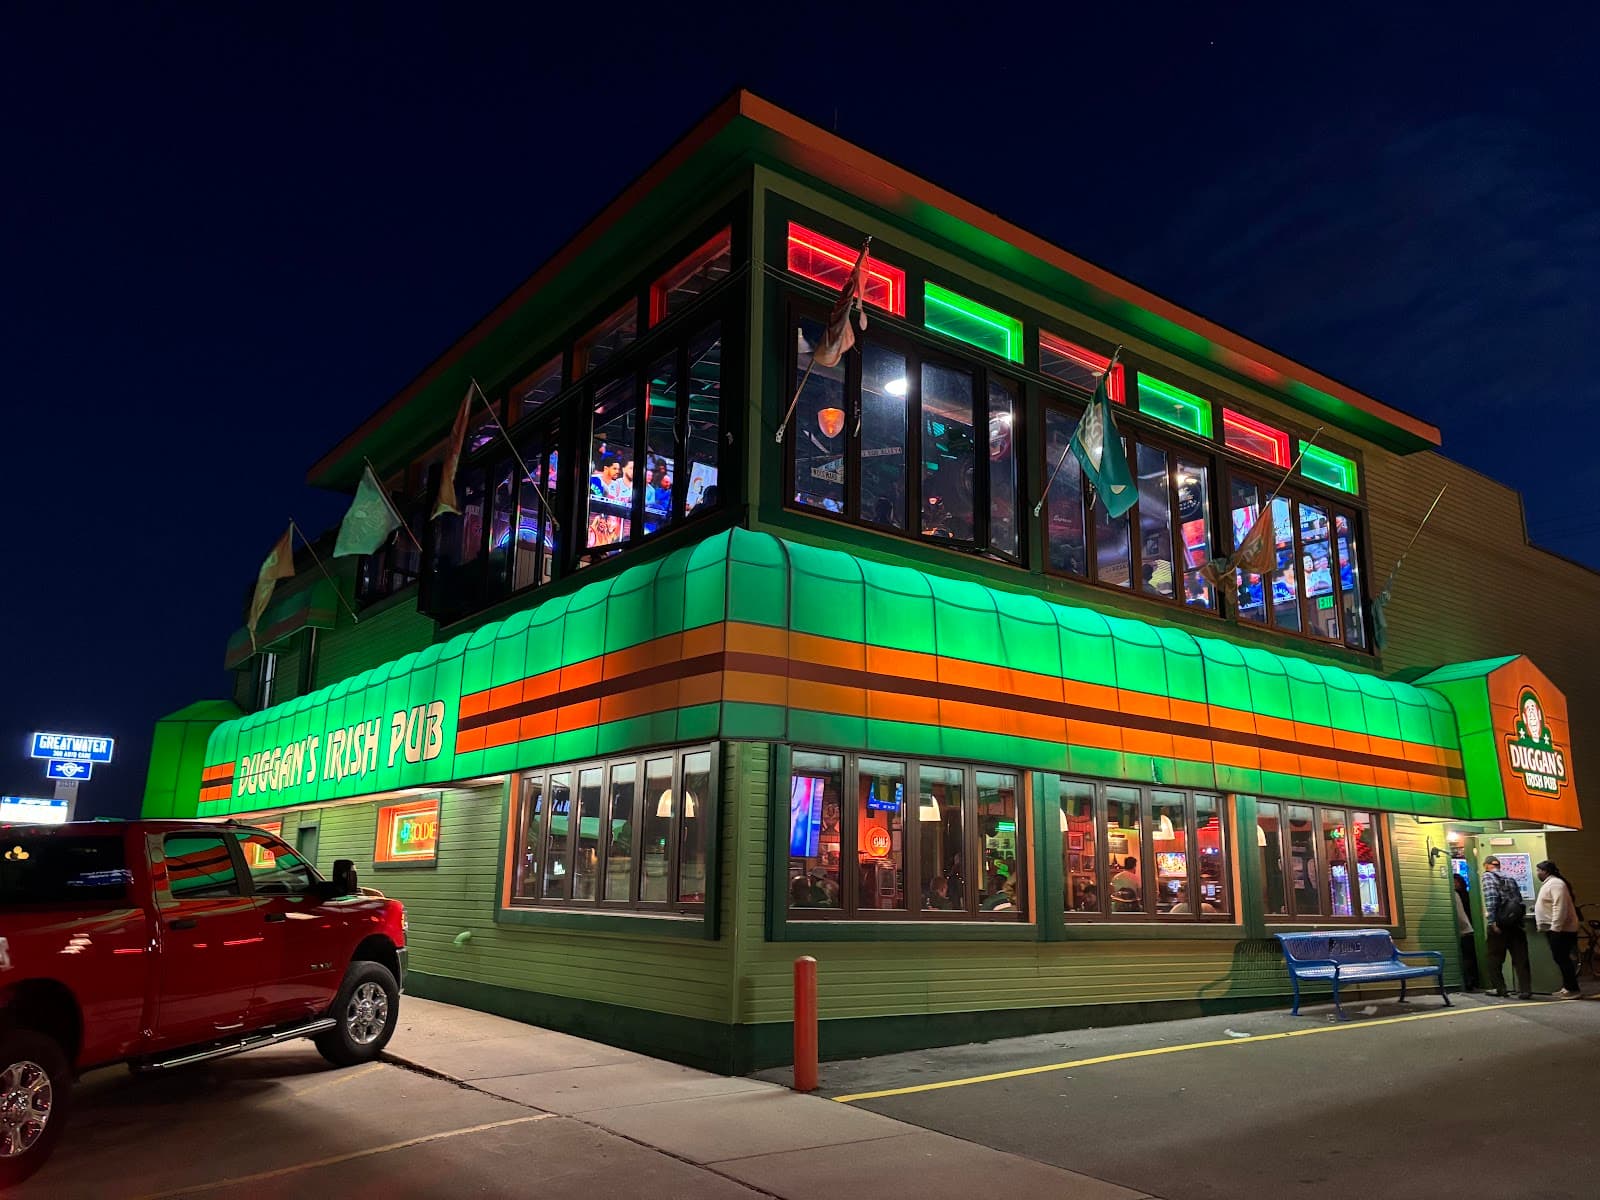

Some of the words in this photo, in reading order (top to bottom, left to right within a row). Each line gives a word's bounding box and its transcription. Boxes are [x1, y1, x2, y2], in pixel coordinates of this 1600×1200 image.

[237, 734, 319, 797] DUGGAN'S
[323, 717, 382, 783] IRISH
[387, 699, 445, 768] PUB
[1509, 743, 1565, 777] DUGGAN'S
[1525, 772, 1543, 789] IRISH
[1543, 775, 1557, 791] PUB
